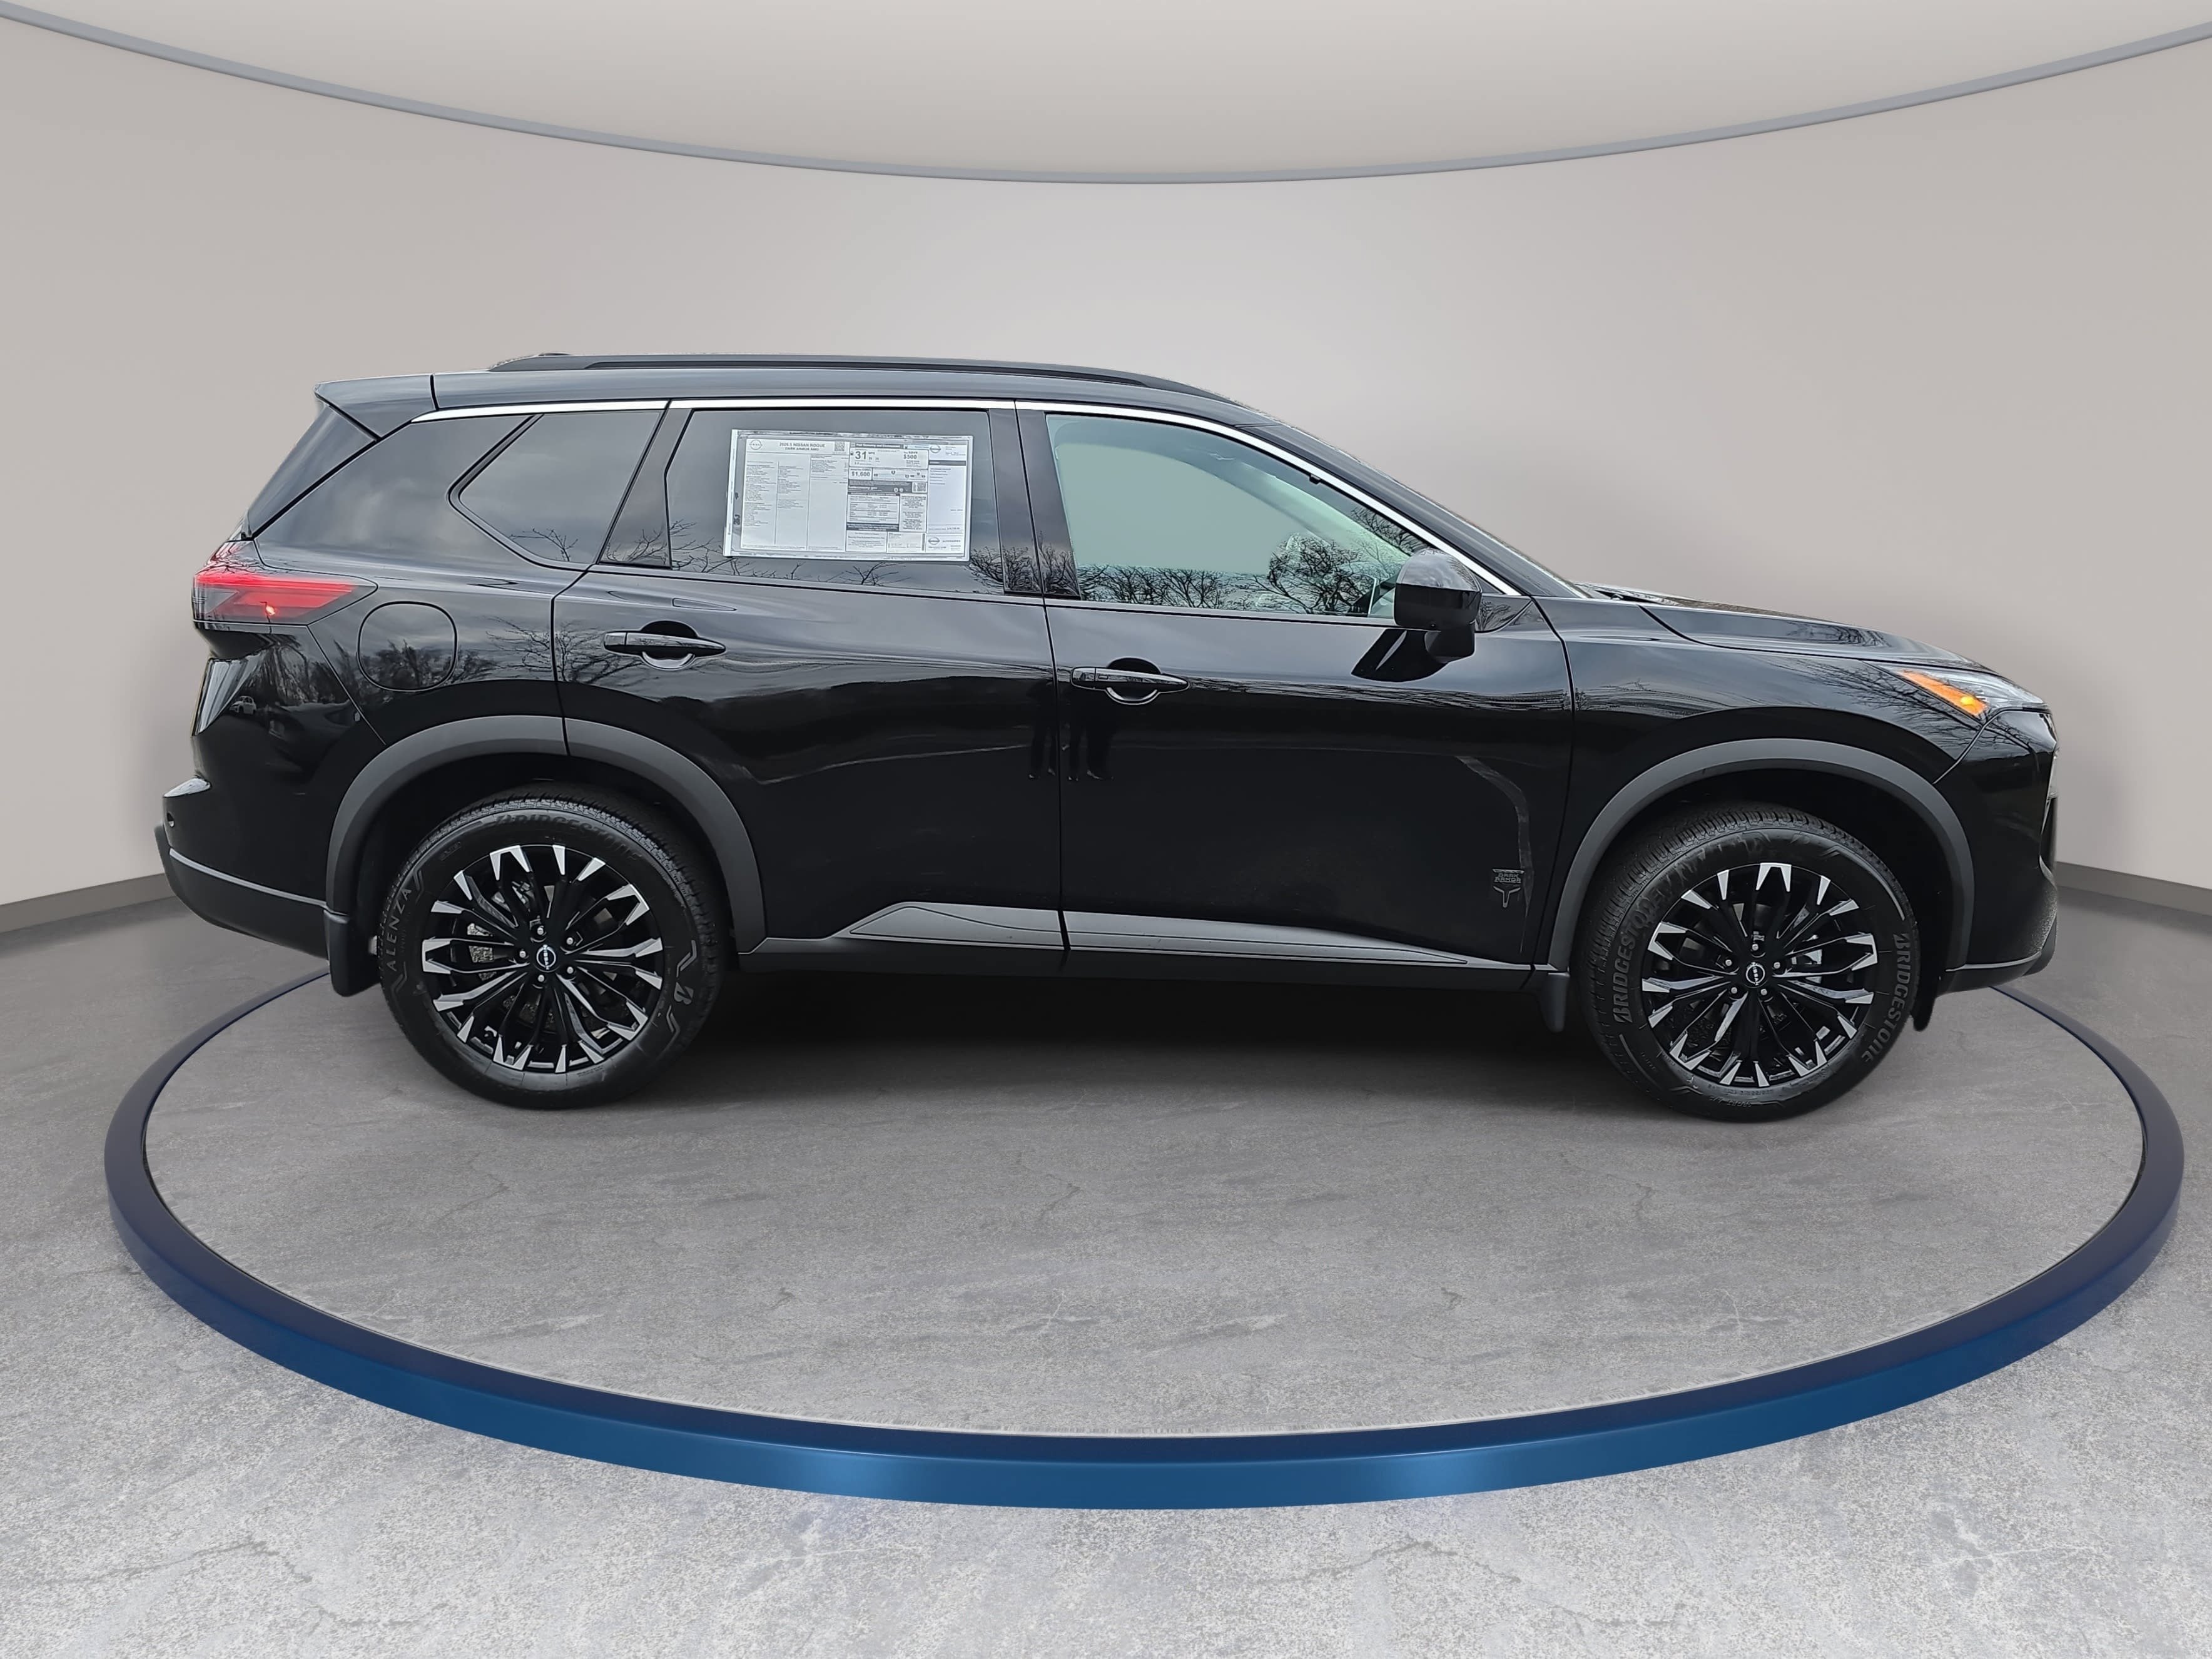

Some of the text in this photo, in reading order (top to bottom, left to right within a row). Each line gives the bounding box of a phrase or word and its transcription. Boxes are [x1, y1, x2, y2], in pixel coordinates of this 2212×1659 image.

[855, 451, 866, 459] 31
[386, 887, 412, 972] ALENZA
[1861, 932, 1911, 1063] BRIDGESTONE
